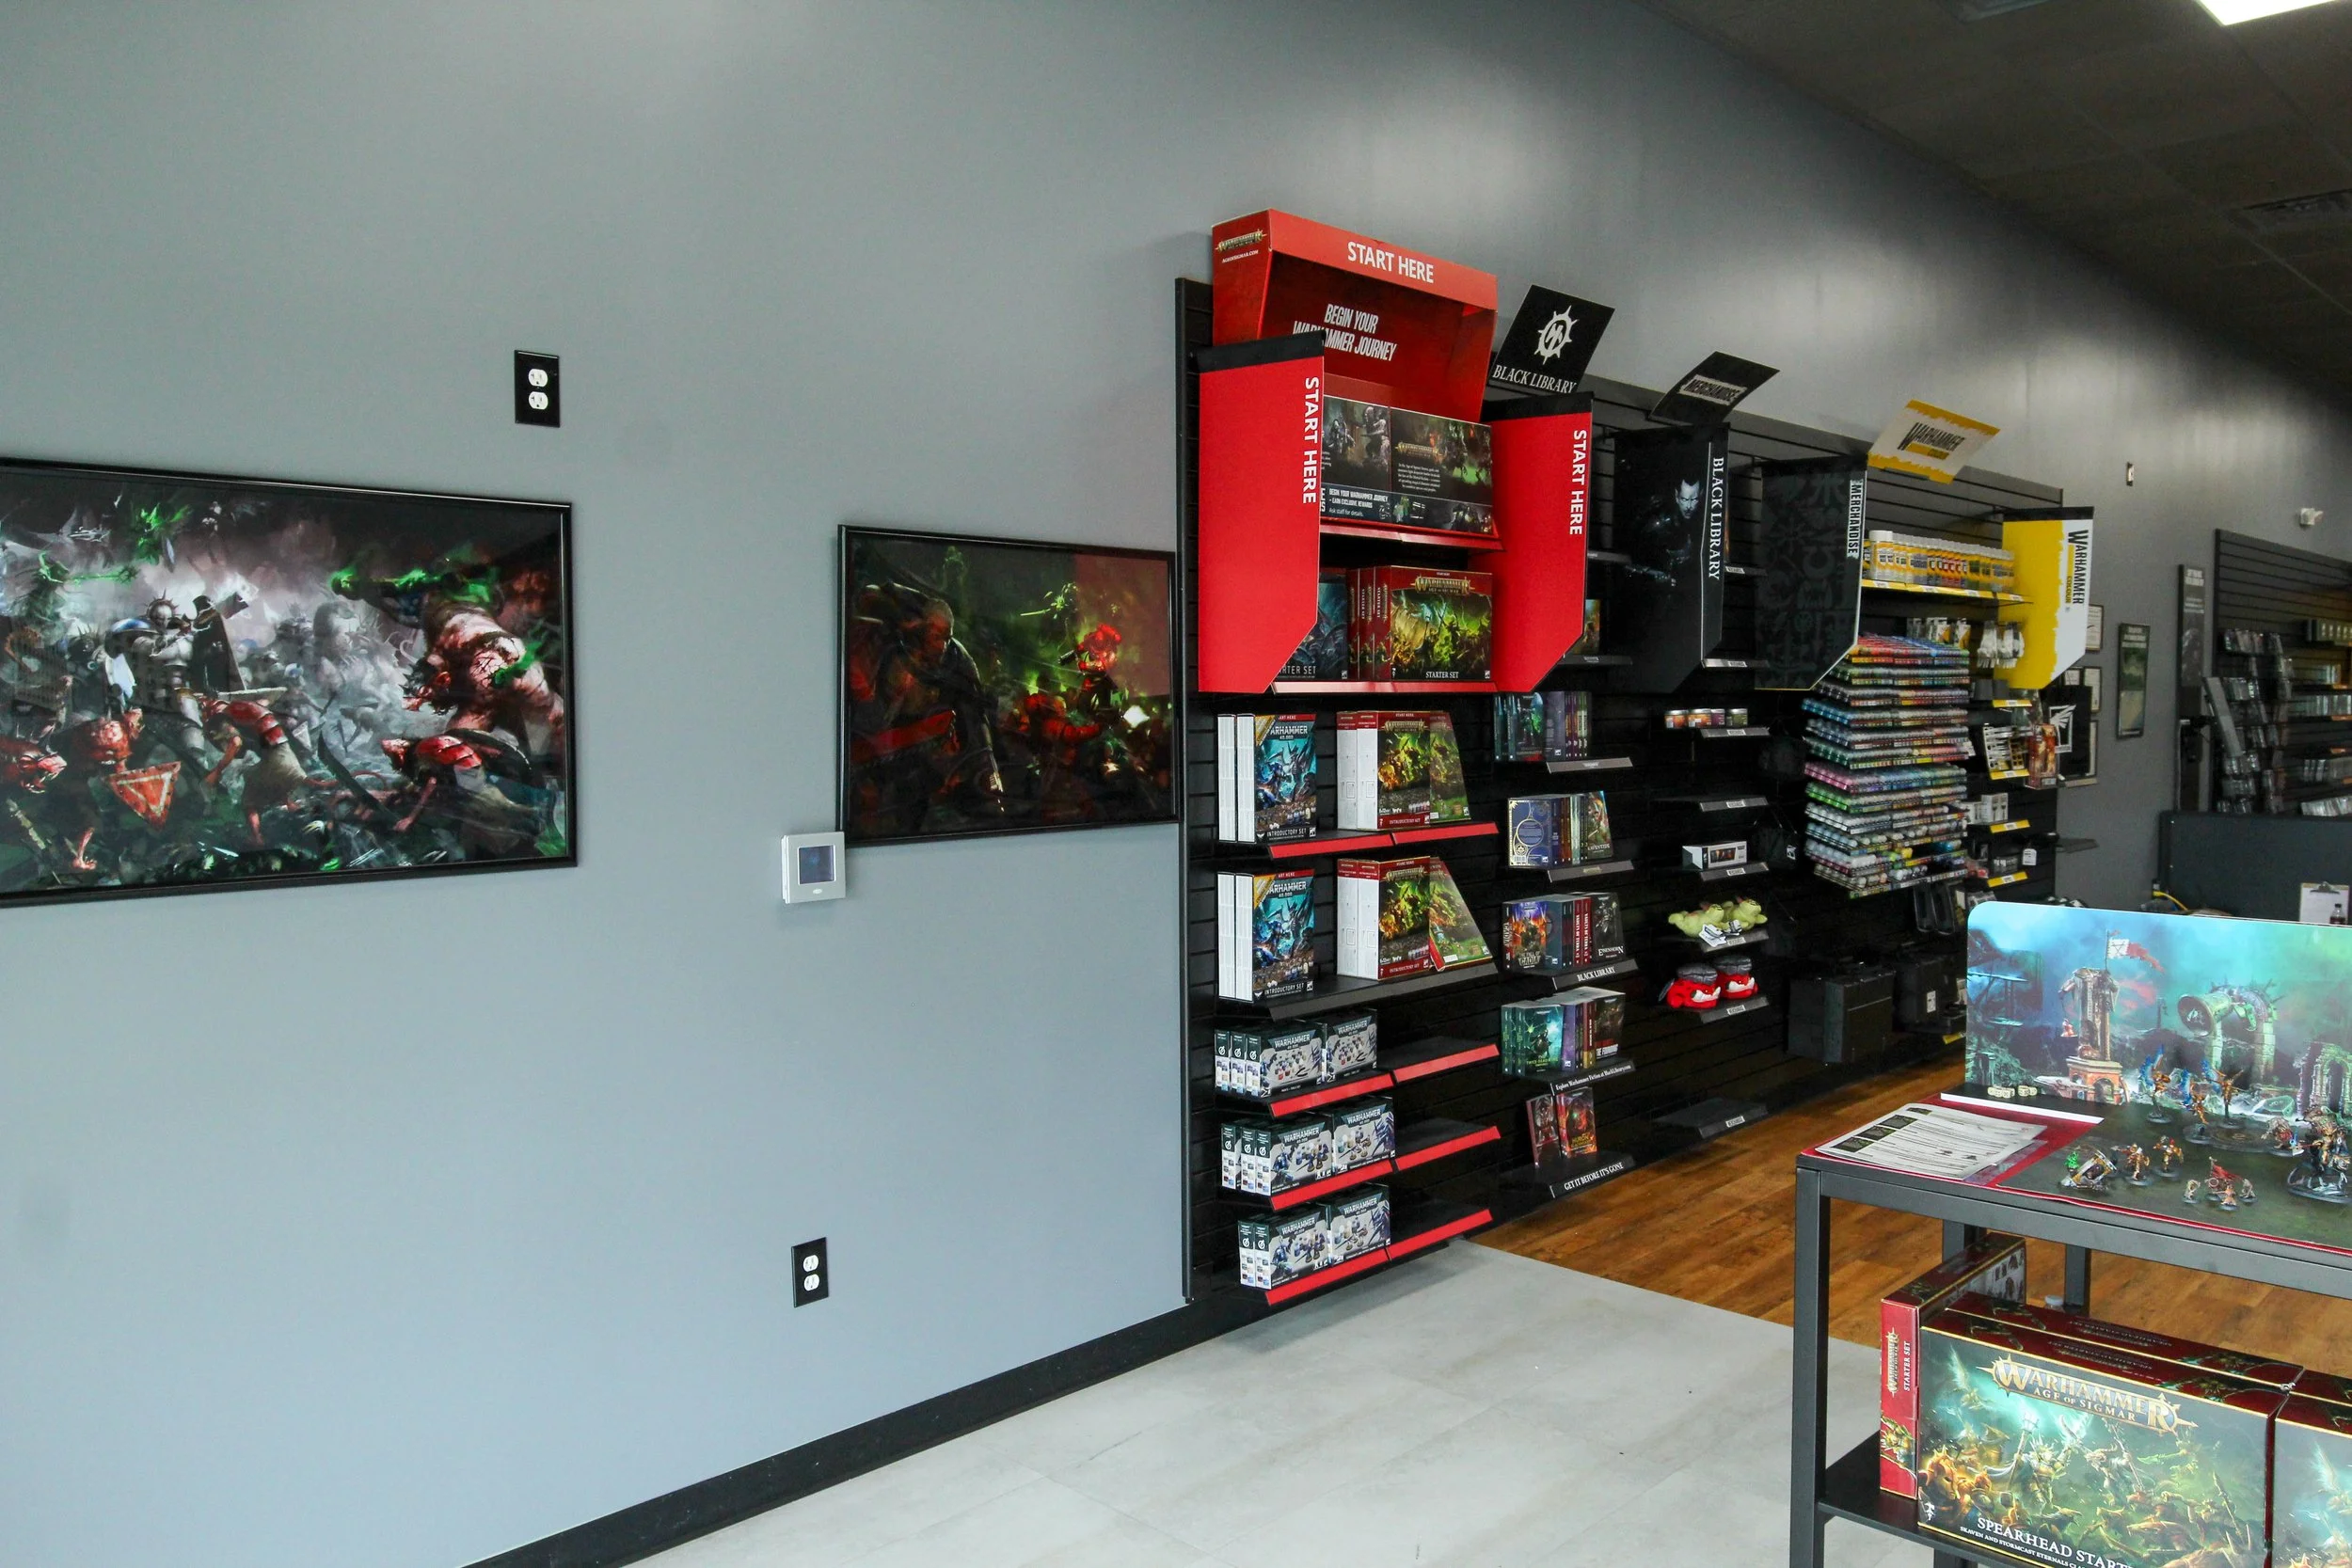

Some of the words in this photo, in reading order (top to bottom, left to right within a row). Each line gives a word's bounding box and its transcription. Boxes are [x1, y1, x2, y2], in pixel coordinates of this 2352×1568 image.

[1347, 241, 1394, 272] START
[1398, 258, 1434, 283] HERE
[1324, 304, 1354, 327] BEGIN
[1354, 310, 1379, 334] YOUR
[1355, 336, 1397, 361] JOURNEY
[1492, 364, 1529, 386] BLACK
[1530, 373, 1578, 393] LIBRARY
[1304, 376, 1319, 444] START
[1572, 429, 1587, 485] START
[1302, 450, 1318, 504] HERE
[1710, 456, 1724, 508] BLACK
[1569, 490, 1585, 535] HERE
[1848, 484, 1861, 555] MERCHANDISE
[1708, 512, 1724, 580] LIBRARY
[2068, 530, 2089, 604] WARHAMMER
[1304, 666, 1316, 674] SET
[1270, 725, 1308, 735] ARHAMMER
[1266, 829, 1298, 837] INTRODUCTORY
[1269, 880, 1306, 893] ARHAMMER
[1577, 970, 1596, 982] BLACK
[1595, 966, 1616, 978] LIBRARY
[1264, 985, 1295, 995] INTRODUCTORY
[1274, 1034, 1311, 1048] WARHAMMER
[1338, 1020, 1368, 1034] WARHAMMER
[1347, 1108, 1381, 1125] WARHAMMER
[1283, 1127, 1320, 1143] WARHAMMER
[1564, 1180, 1576, 1191] GET
[1574, 1178, 1581, 1187] IT
[1581, 1171, 1600, 1184] BEFORE
[1599, 1167, 1610, 1178] IT'S
[1609, 1162, 1624, 1173] GONE
[1343, 1197, 1377, 1214] WARHAMMER
[1281, 1216, 1315, 1234] WARHAMMER
[1997, 1361, 2170, 1431] WARHAMMER
[2034, 1389, 2060, 1402] AGE
[2079, 1399, 2136, 1421] SIGMAR
[1960, 1526, 1984, 1538] SKAVEN
[1984, 1535, 1999, 1544] AND
[1999, 1540, 2035, 1555] STORMCAST
[2036, 1551, 2069, 1567] ETERNALS
[1977, 1517, 2073, 1558] SPEARHEAD
